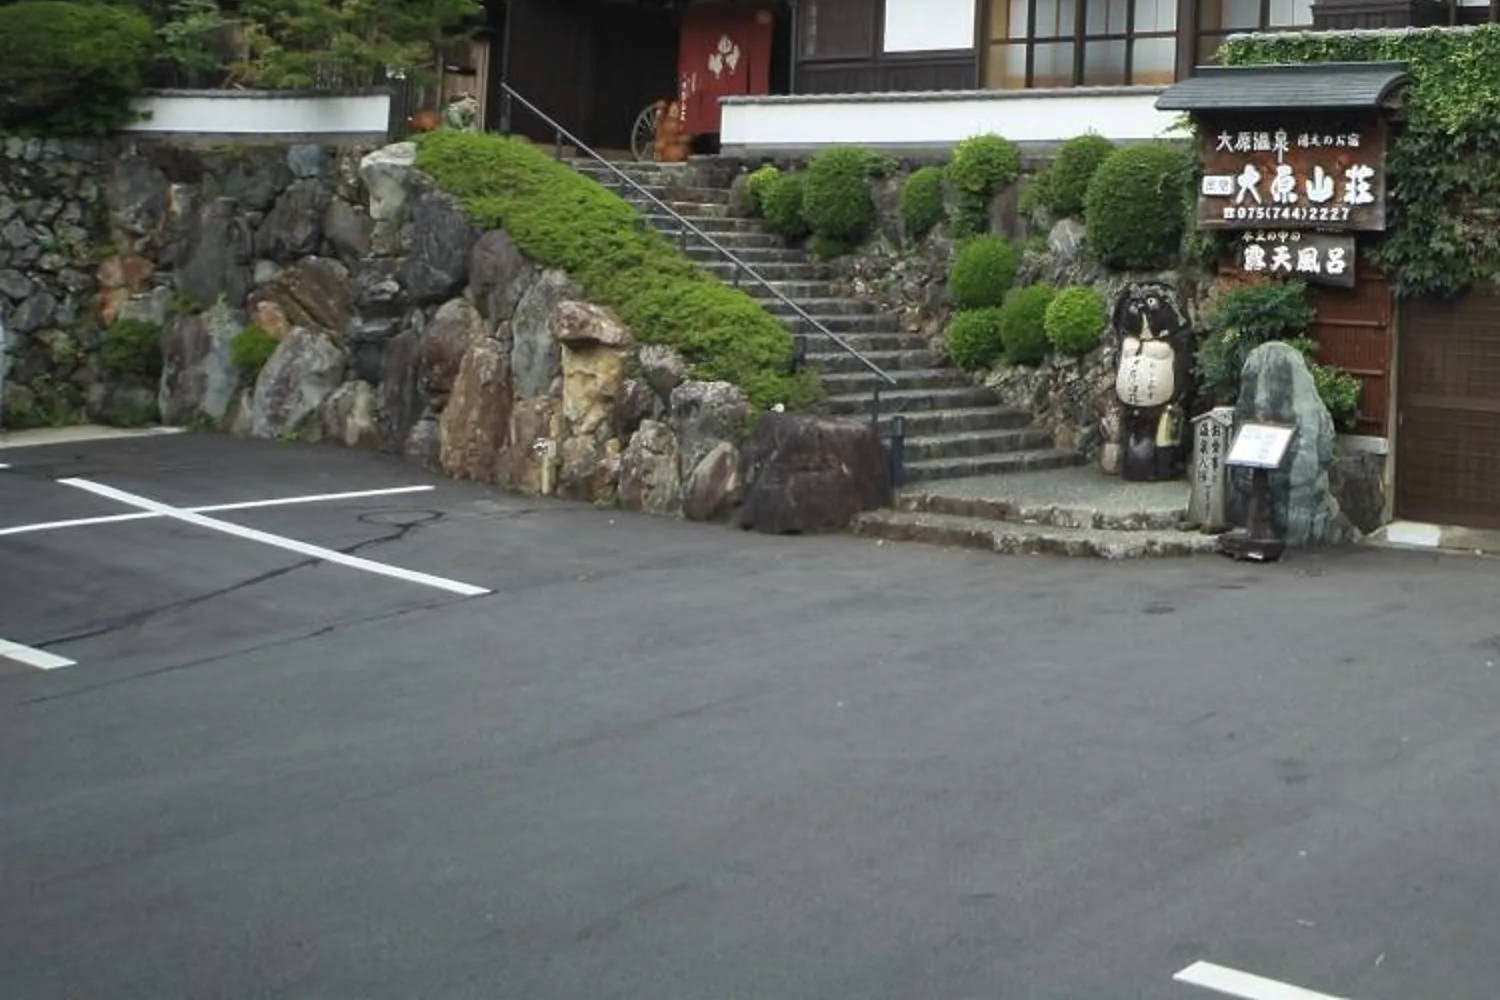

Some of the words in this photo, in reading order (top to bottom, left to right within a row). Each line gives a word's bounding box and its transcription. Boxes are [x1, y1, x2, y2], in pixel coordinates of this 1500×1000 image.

[1216, 129, 1289, 152] 大原温泉
[1236, 164, 1375, 205] 大原山荘
[1237, 207, 1350, 220] 075(744)2227
[1243, 246, 1346, 274] 露天風呂
